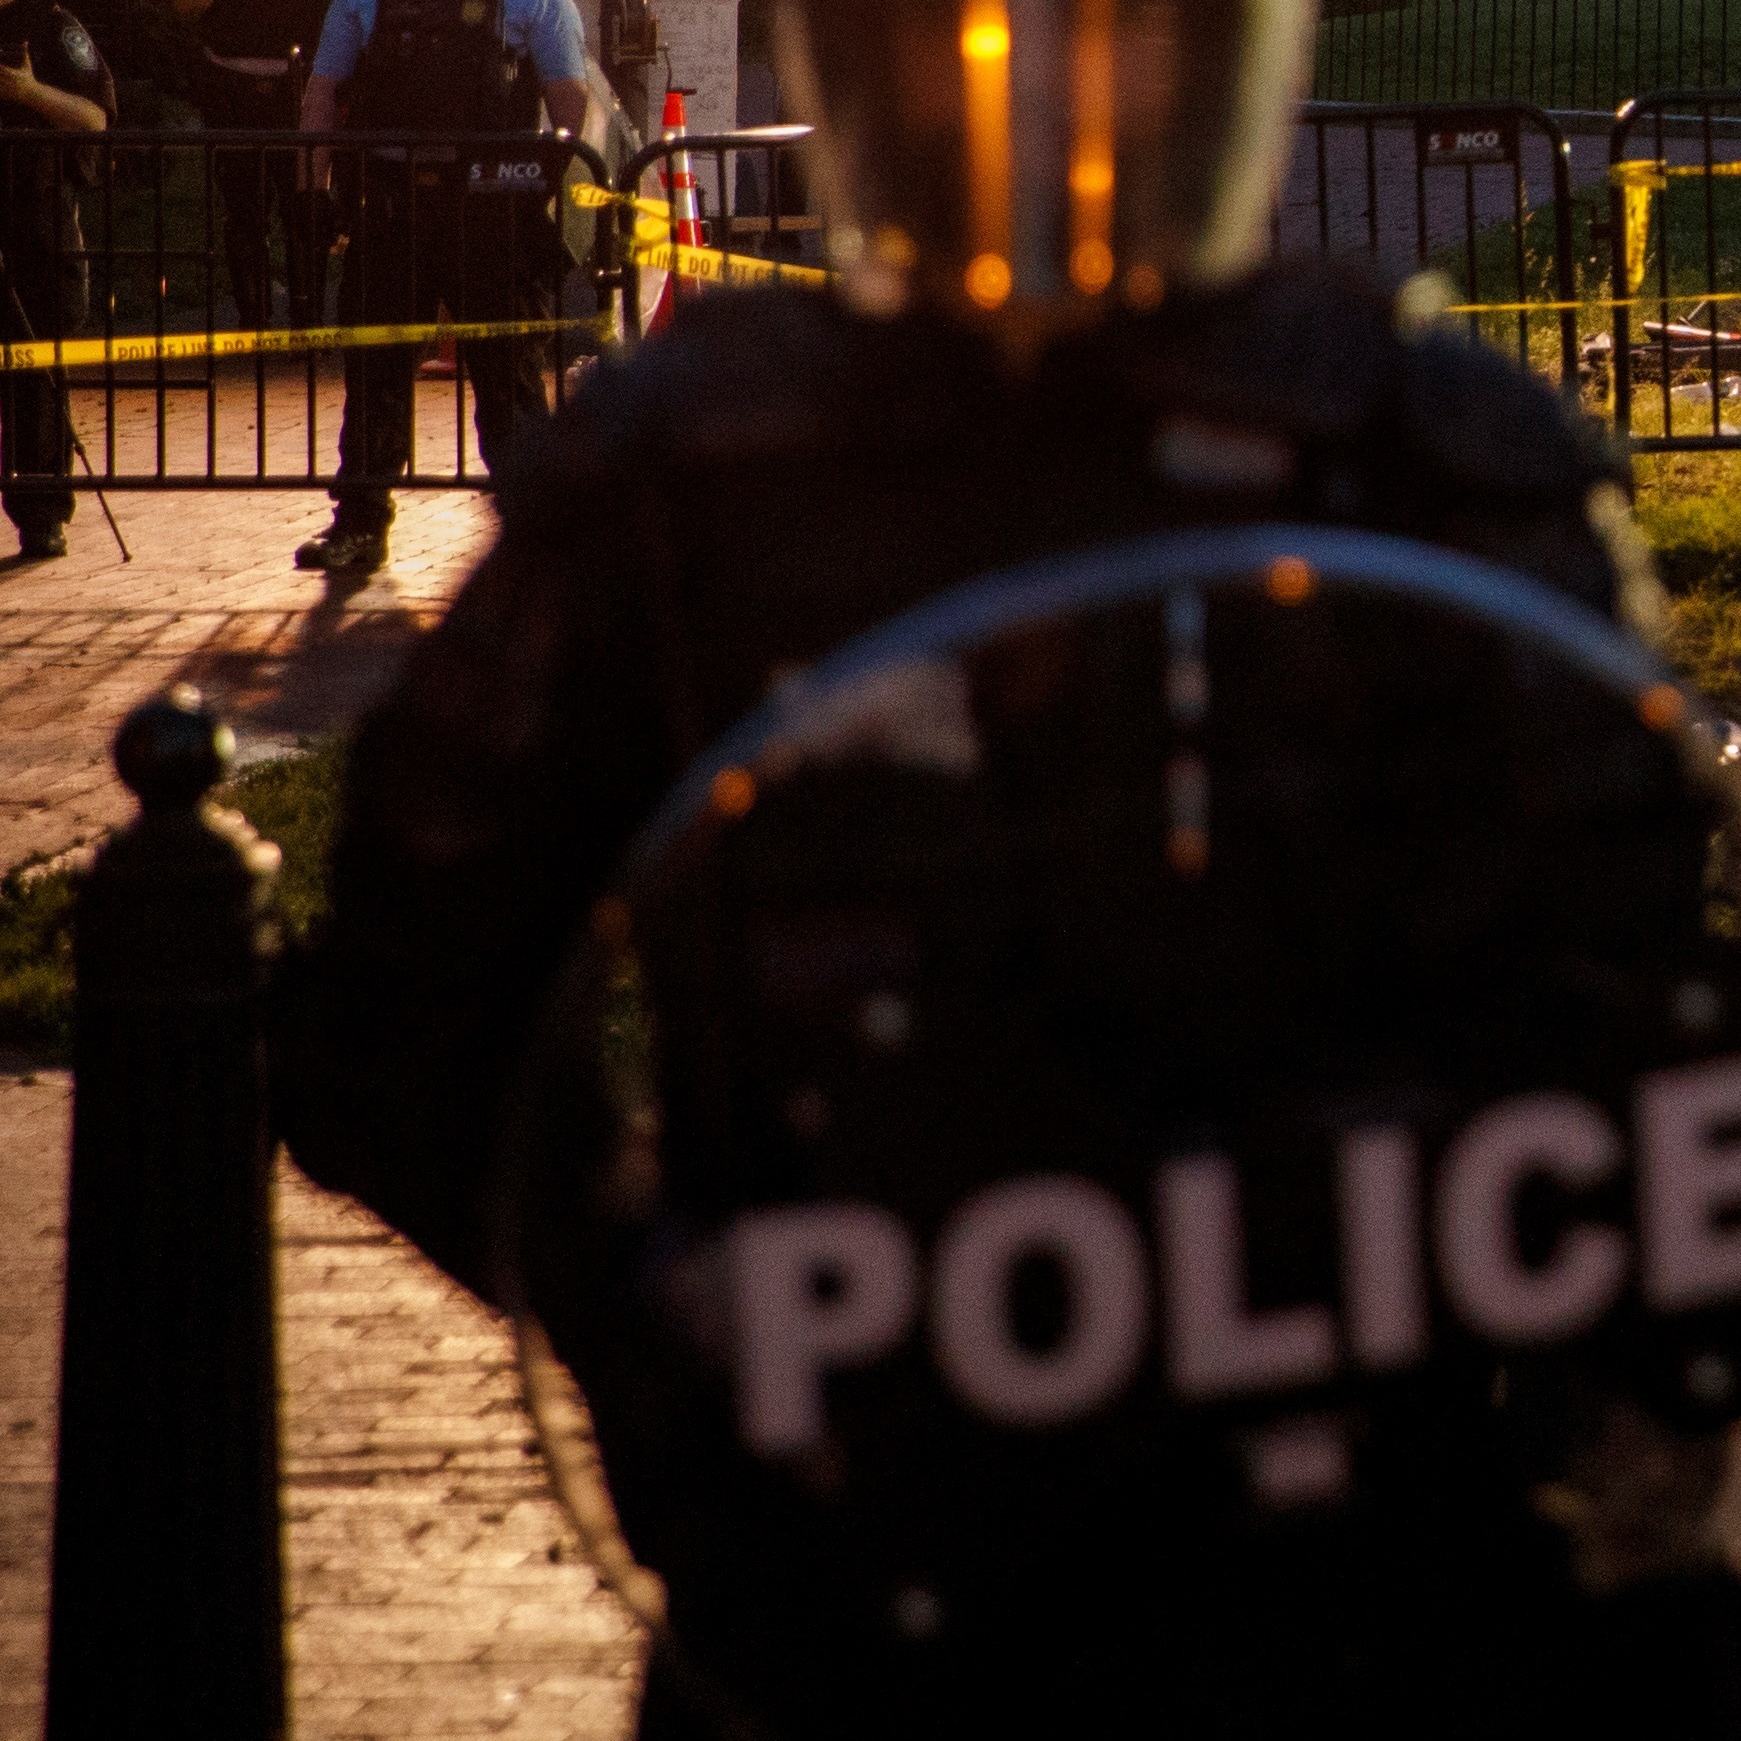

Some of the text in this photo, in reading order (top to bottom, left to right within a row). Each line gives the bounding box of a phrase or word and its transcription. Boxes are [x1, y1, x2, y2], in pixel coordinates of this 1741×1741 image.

[1428, 130, 1500, 150] SNCO
[470, 162, 542, 180] SNCO
[688, 256, 711, 276] DO
[182, 339, 208, 358] LIN
